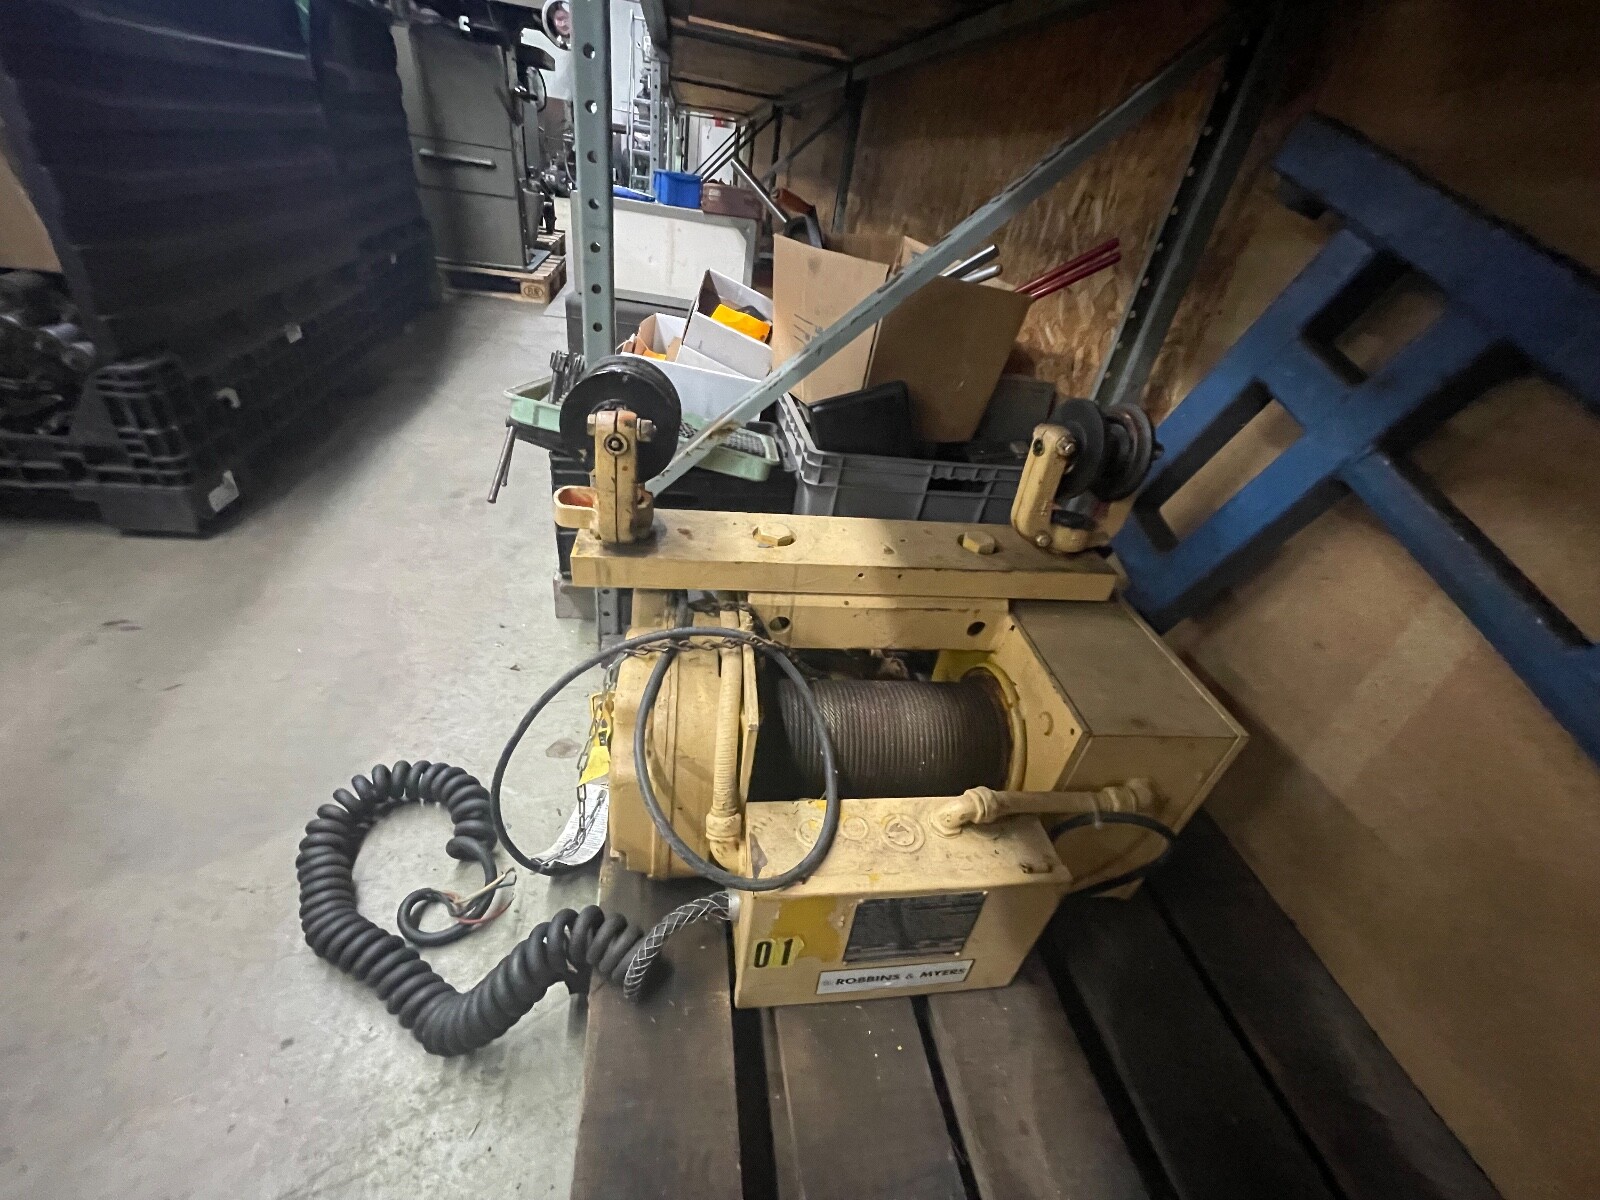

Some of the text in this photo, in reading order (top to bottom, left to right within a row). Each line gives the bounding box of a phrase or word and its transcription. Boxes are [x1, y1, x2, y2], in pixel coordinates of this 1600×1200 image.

[754, 938, 794, 968] 01
[835, 973, 900, 985] ROBBINS
[919, 967, 966, 979] MYERS
